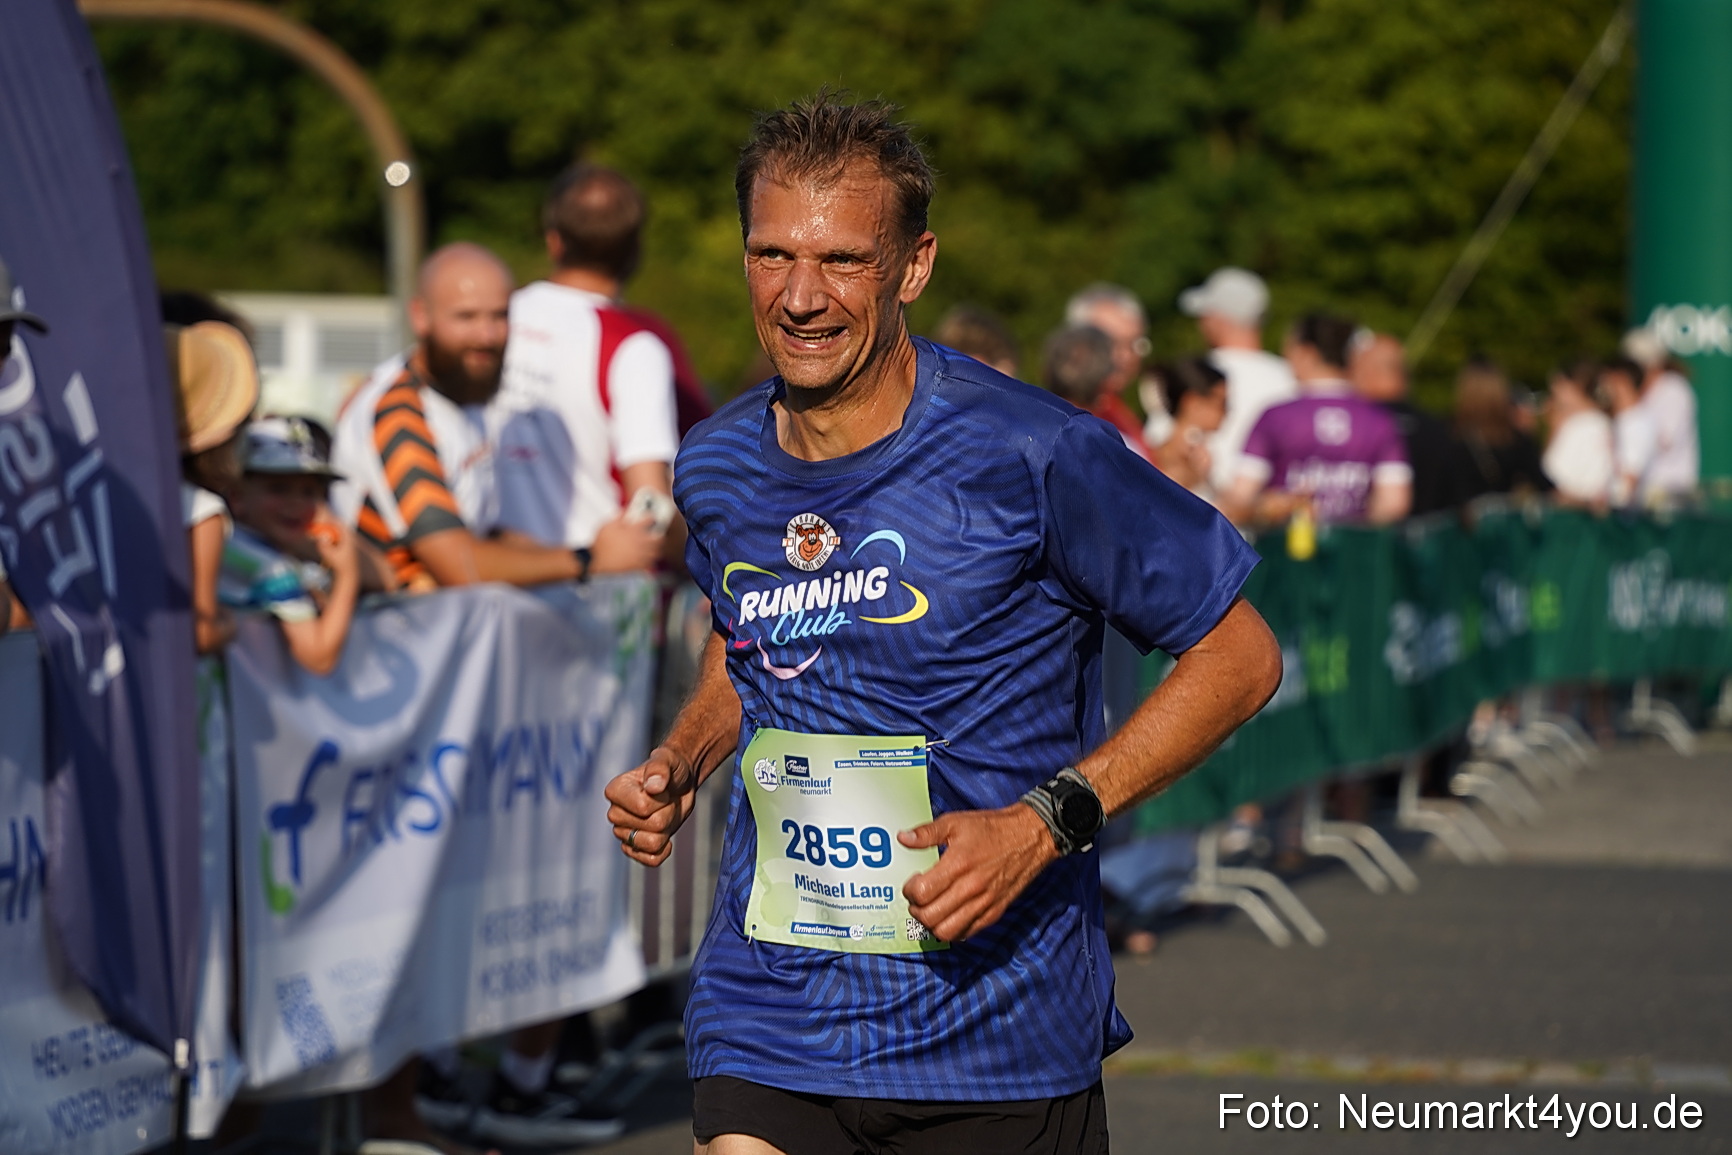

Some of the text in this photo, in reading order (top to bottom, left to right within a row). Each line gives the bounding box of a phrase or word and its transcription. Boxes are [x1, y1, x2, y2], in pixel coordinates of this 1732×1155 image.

[771, 603, 852, 646] Club
[780, 776, 832, 788] Firmenlauf
[781, 818, 892, 869] 2859
[794, 872, 894, 902] Michael Lang
[794, 924, 847, 937] firmenlauf.bayern
